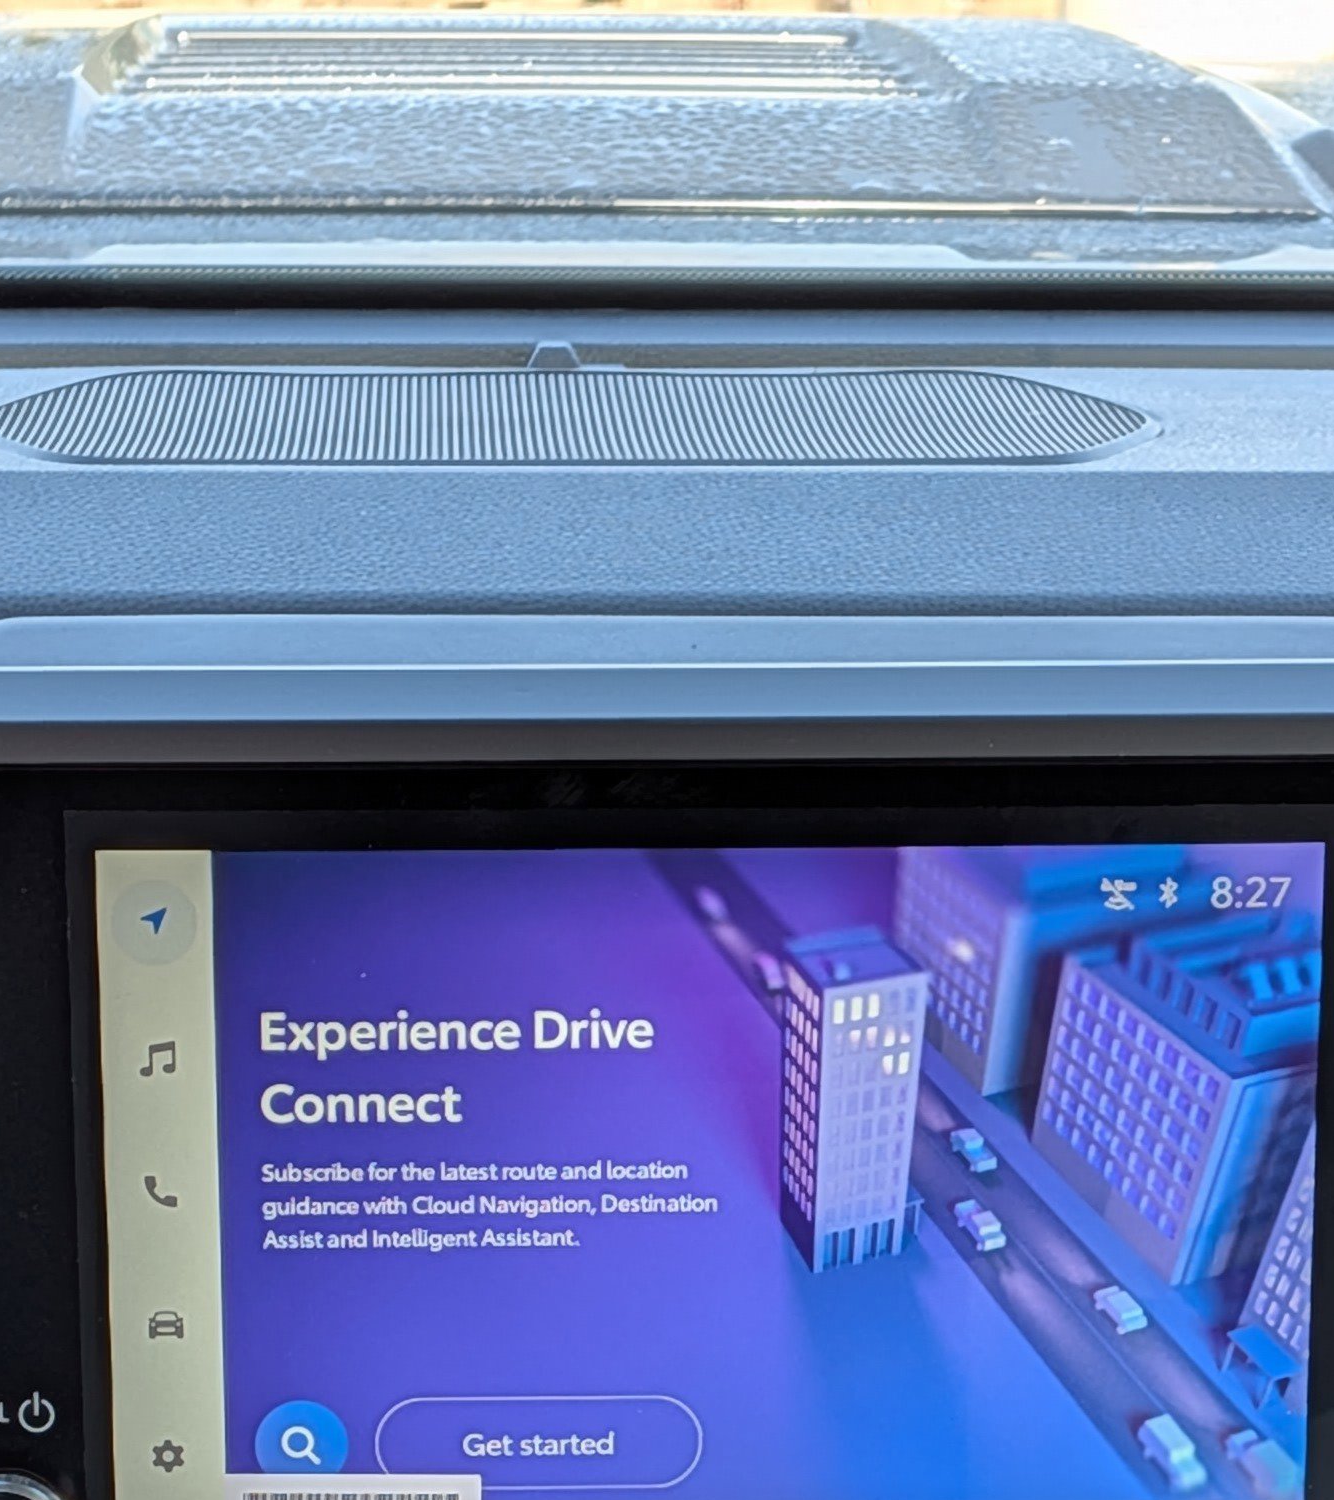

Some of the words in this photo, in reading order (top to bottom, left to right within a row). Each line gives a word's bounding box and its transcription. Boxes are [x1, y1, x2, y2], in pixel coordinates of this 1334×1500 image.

[1210, 876, 1292, 909] 8:27
[259, 1009, 521, 1061] Experience
[533, 1008, 655, 1049] Drive
[260, 1083, 463, 1124] Connect
[261, 1162, 364, 1183] Subscribe
[367, 1161, 398, 1182] for
[400, 1161, 435, 1182] the
[440, 1161, 499, 1181] latest
[502, 1163, 557, 1181] route
[560, 1159, 602, 1180] and
[606, 1159, 688, 1180] location
[261, 1196, 360, 1221] guidance
[363, 1195, 408, 1215] with
[411, 1195, 475, 1215] Cloud
[479, 1195, 597, 1219] Navigation,
[601, 1193, 718, 1214] Destination
[262, 1229, 324, 1250] Assist
[326, 1228, 368, 1249] and
[372, 1228, 478, 1252] Intelligent
[480, 1228, 581, 1248] Assistant.
[462, 1433, 514, 1457] Get
[519, 1431, 616, 1457] started
